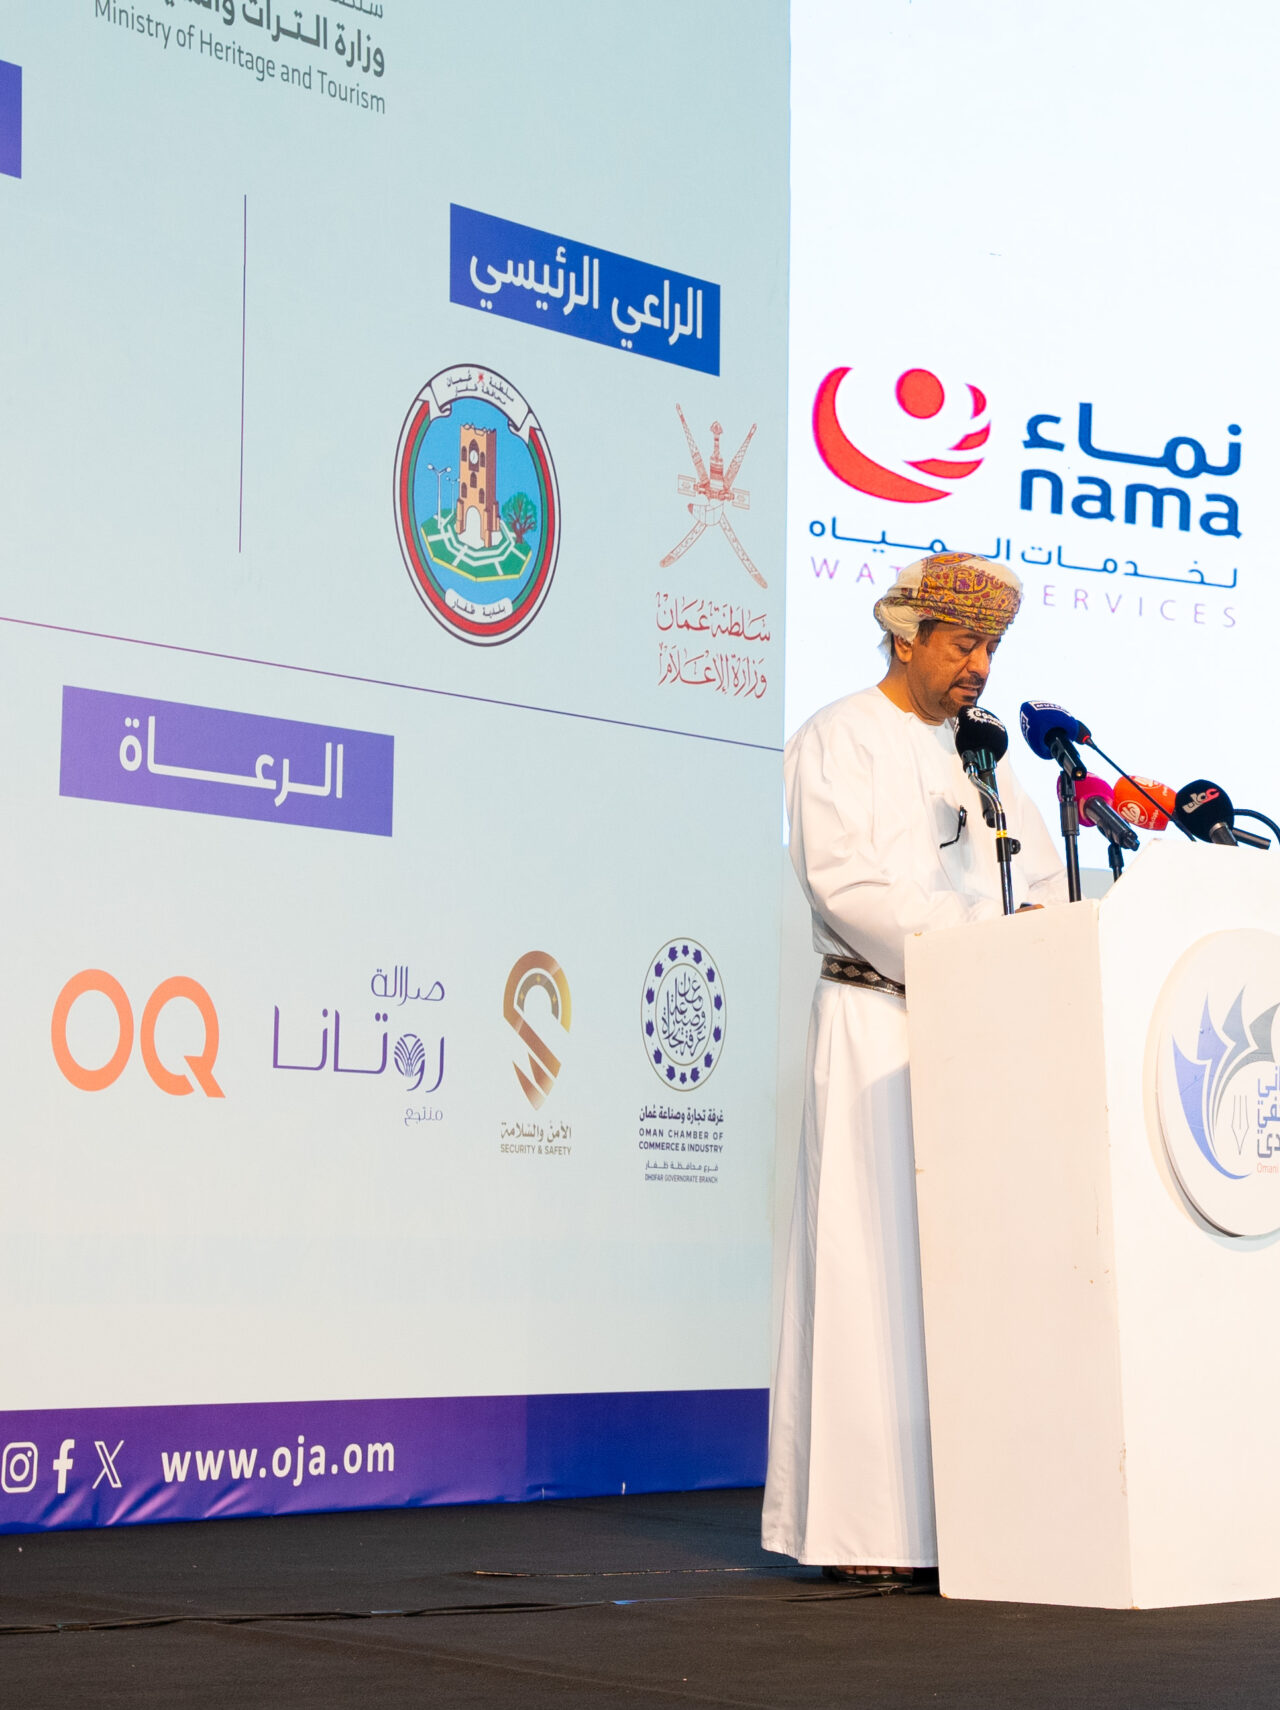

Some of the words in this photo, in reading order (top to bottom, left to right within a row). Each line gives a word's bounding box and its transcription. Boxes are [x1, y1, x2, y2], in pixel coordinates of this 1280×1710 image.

[95, 0, 171, 49] Ministry
[176, 24, 195, 50] of
[200, 29, 275, 82] Heritage
[281, 63, 312, 90] and
[317, 70, 385, 114] Tourism
[335, 22, 385, 77] وزارة
[470, 246, 599, 315] الرئيسي
[611, 279, 703, 349] الراعي
[1022, 402, 1242, 479] نماء
[1020, 469, 1243, 539] nama
[809, 516, 1011, 561] المياه
[1021, 545, 1238, 589] لخدمات
[1043, 584, 1237, 628] ERVICES
[119, 715, 344, 807] الرعاة
[371, 965, 445, 1006] صلالة
[51, 968, 226, 1099] OQ
[273, 1005, 445, 1093] روتانا
[404, 1106, 443, 1127] منتجع
[639, 1128, 664, 1137] OMAN
[668, 1129, 709, 1140] CHAMBER
[713, 1131, 724, 1140] OF
[659, 1105, 685, 1124] وصناعة
[687, 1107, 706, 1125] تجارة
[708, 1108, 724, 1126] غرفة
[500, 1143, 536, 1154] SECURITY
[537, 1145, 543, 1155] &
[544, 1145, 572, 1155] SAFETY
[639, 1141, 679, 1151] COMMERCE
[681, 1143, 686, 1151] &
[687, 1143, 723, 1153] INDUSTRY
[1256, 1162, 1279, 1174] Omani
[699, 1175, 718, 1184] BRANCH
[161, 1434, 395, 1487] www.oja.om
